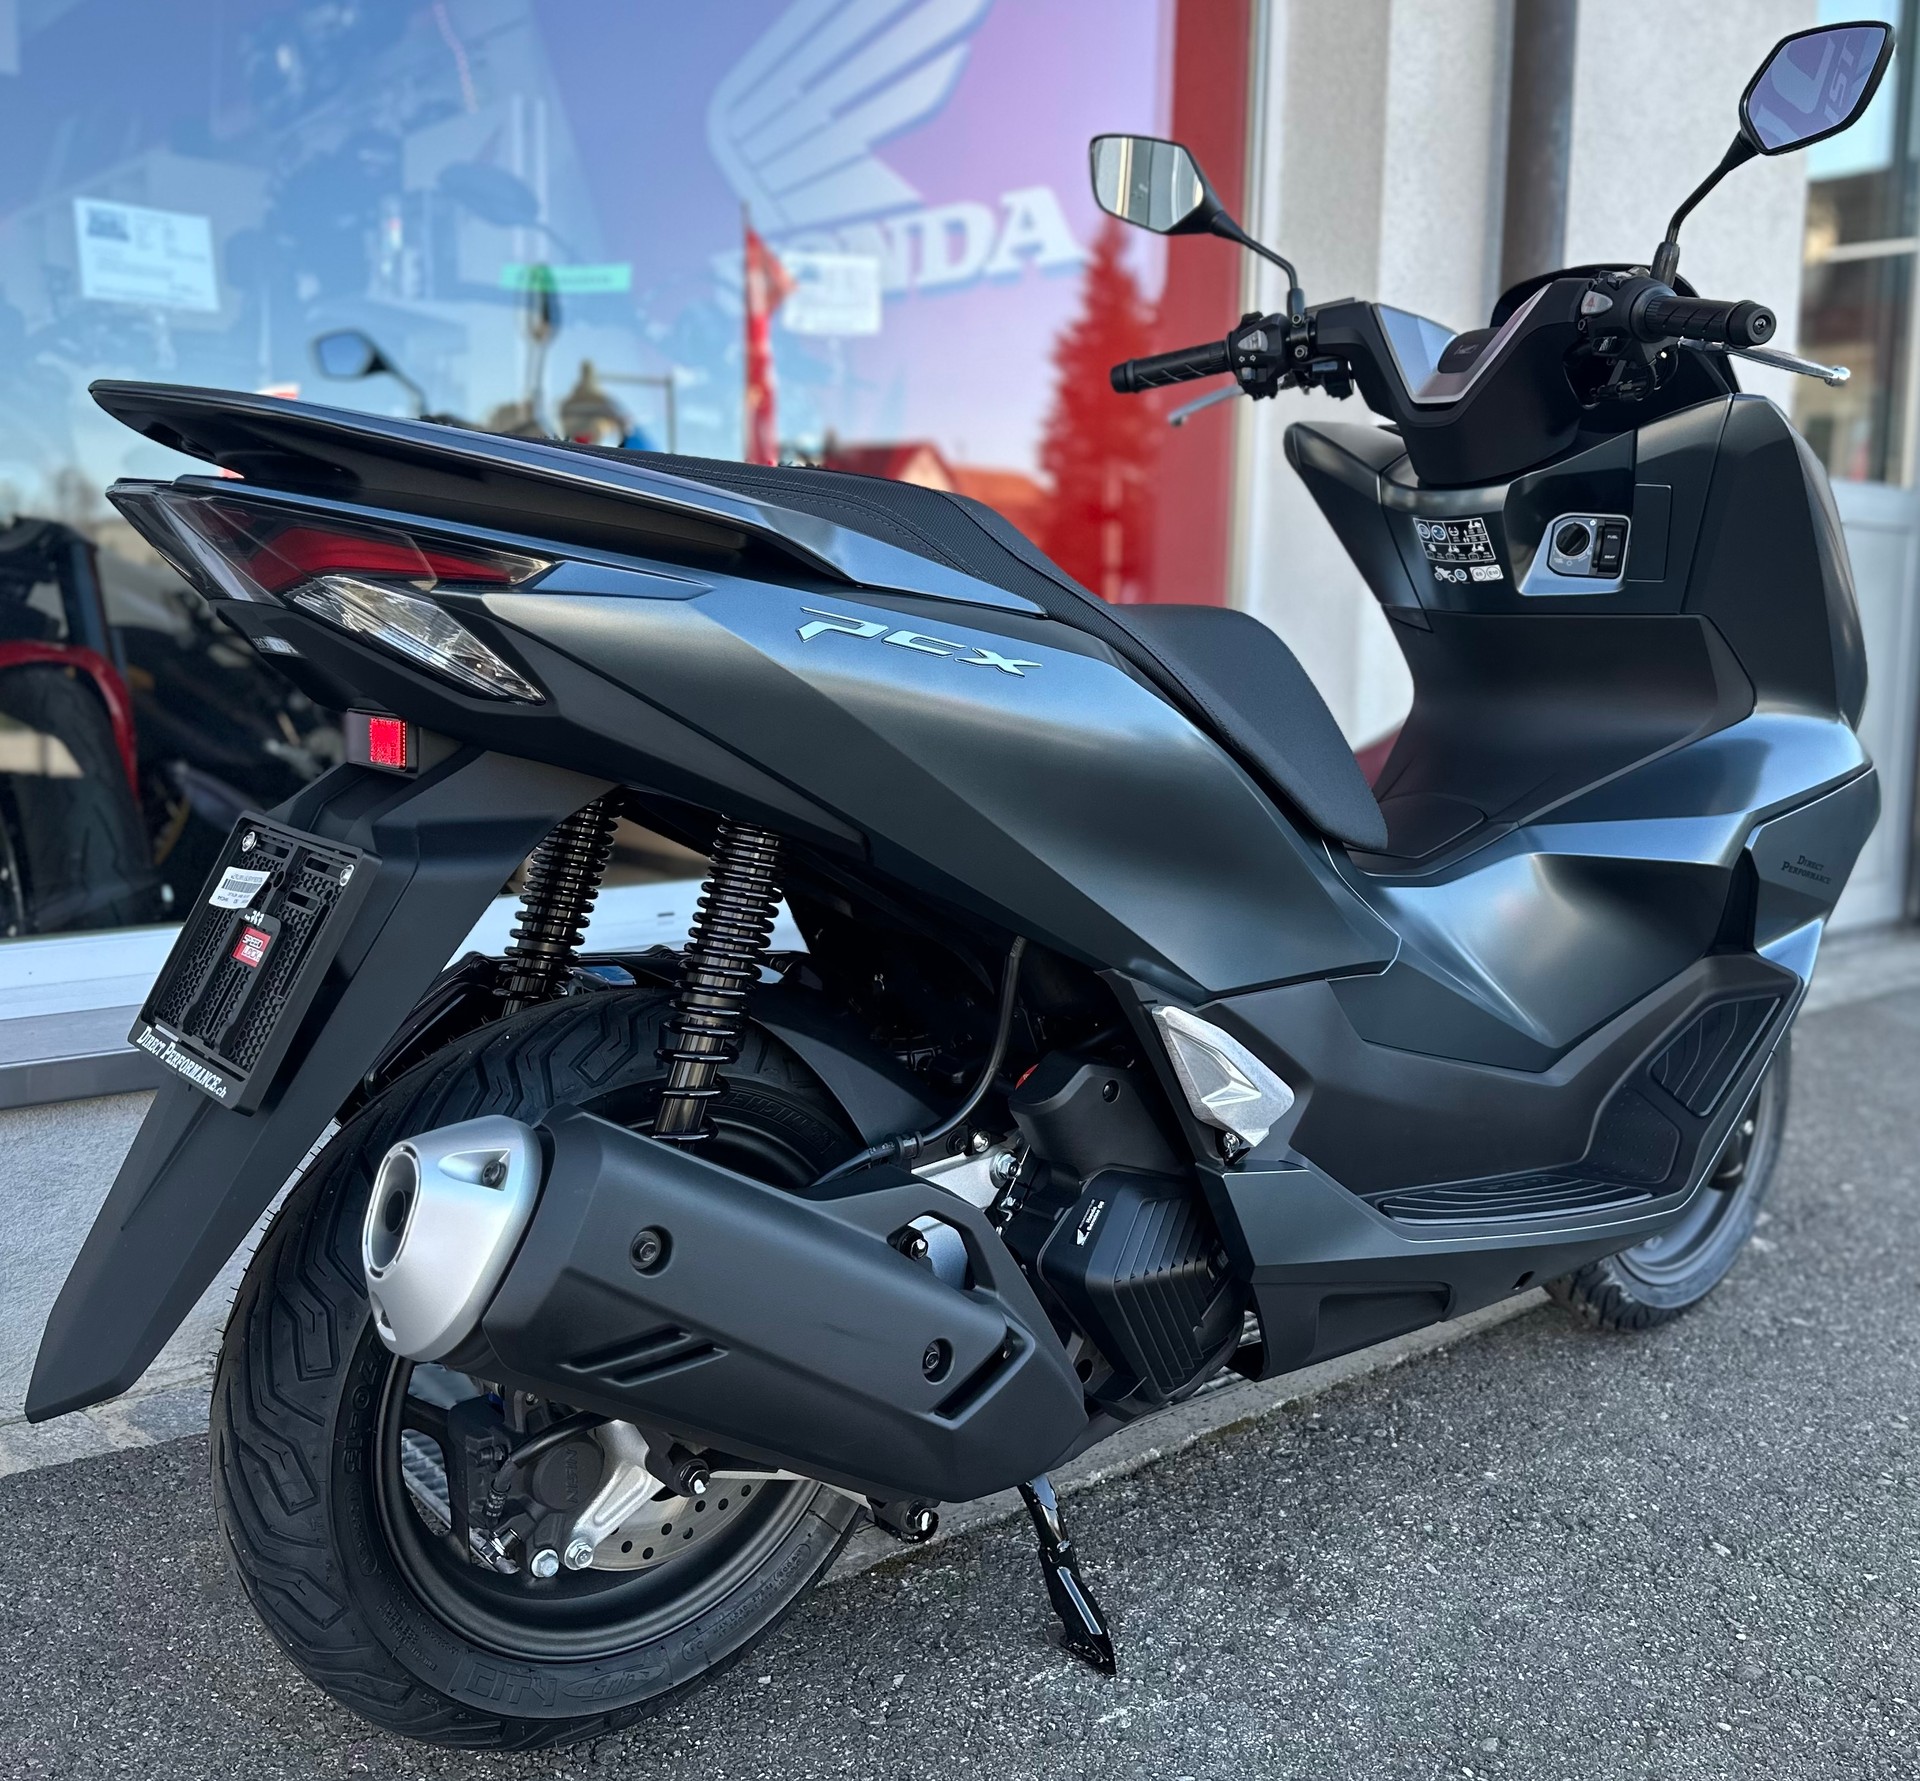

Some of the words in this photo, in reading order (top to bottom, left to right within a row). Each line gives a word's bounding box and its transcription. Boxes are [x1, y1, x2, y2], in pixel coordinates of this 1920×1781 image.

[796, 606, 1043, 678] PCX
[1781, 861, 1832, 885] PERFORMANCE
[1797, 855, 1825, 871] DIRECT
[242, 934, 264, 949] SPEED
[136, 1025, 166, 1057] DIRECT
[160, 1041, 227, 1099] PERFORMANCE.ch
[465, 1662, 557, 1707] CITY
